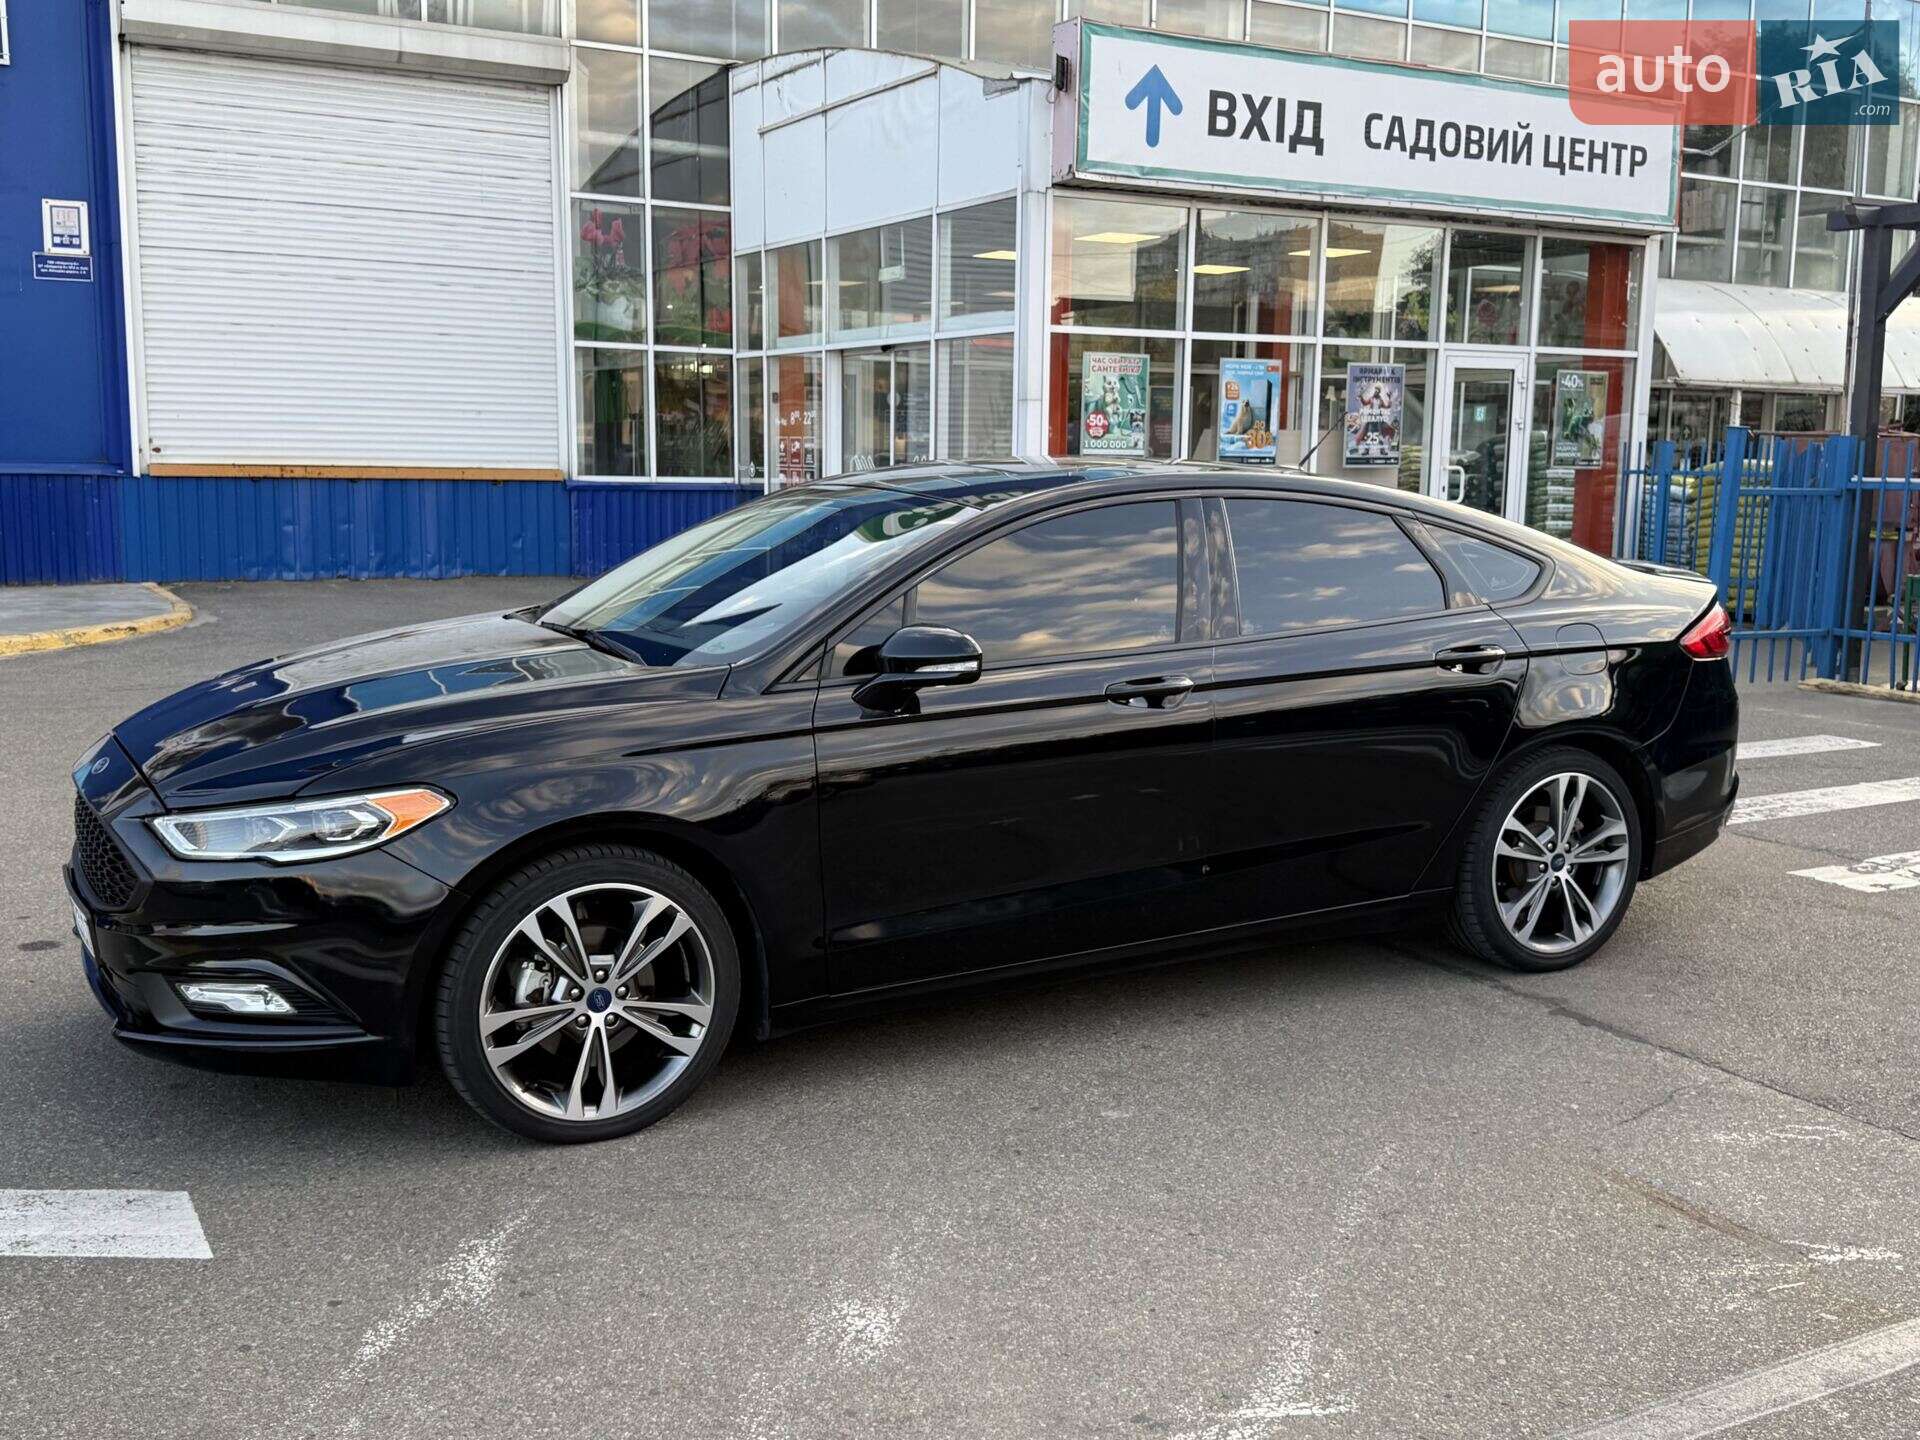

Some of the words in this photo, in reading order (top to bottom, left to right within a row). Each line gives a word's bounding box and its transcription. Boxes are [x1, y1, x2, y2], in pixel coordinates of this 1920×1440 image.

[1206, 89, 1325, 156] ВХІД
[1364, 112, 1533, 167] САДОВИЙ
[1542, 134, 1649, 178] ЦЕНТР
